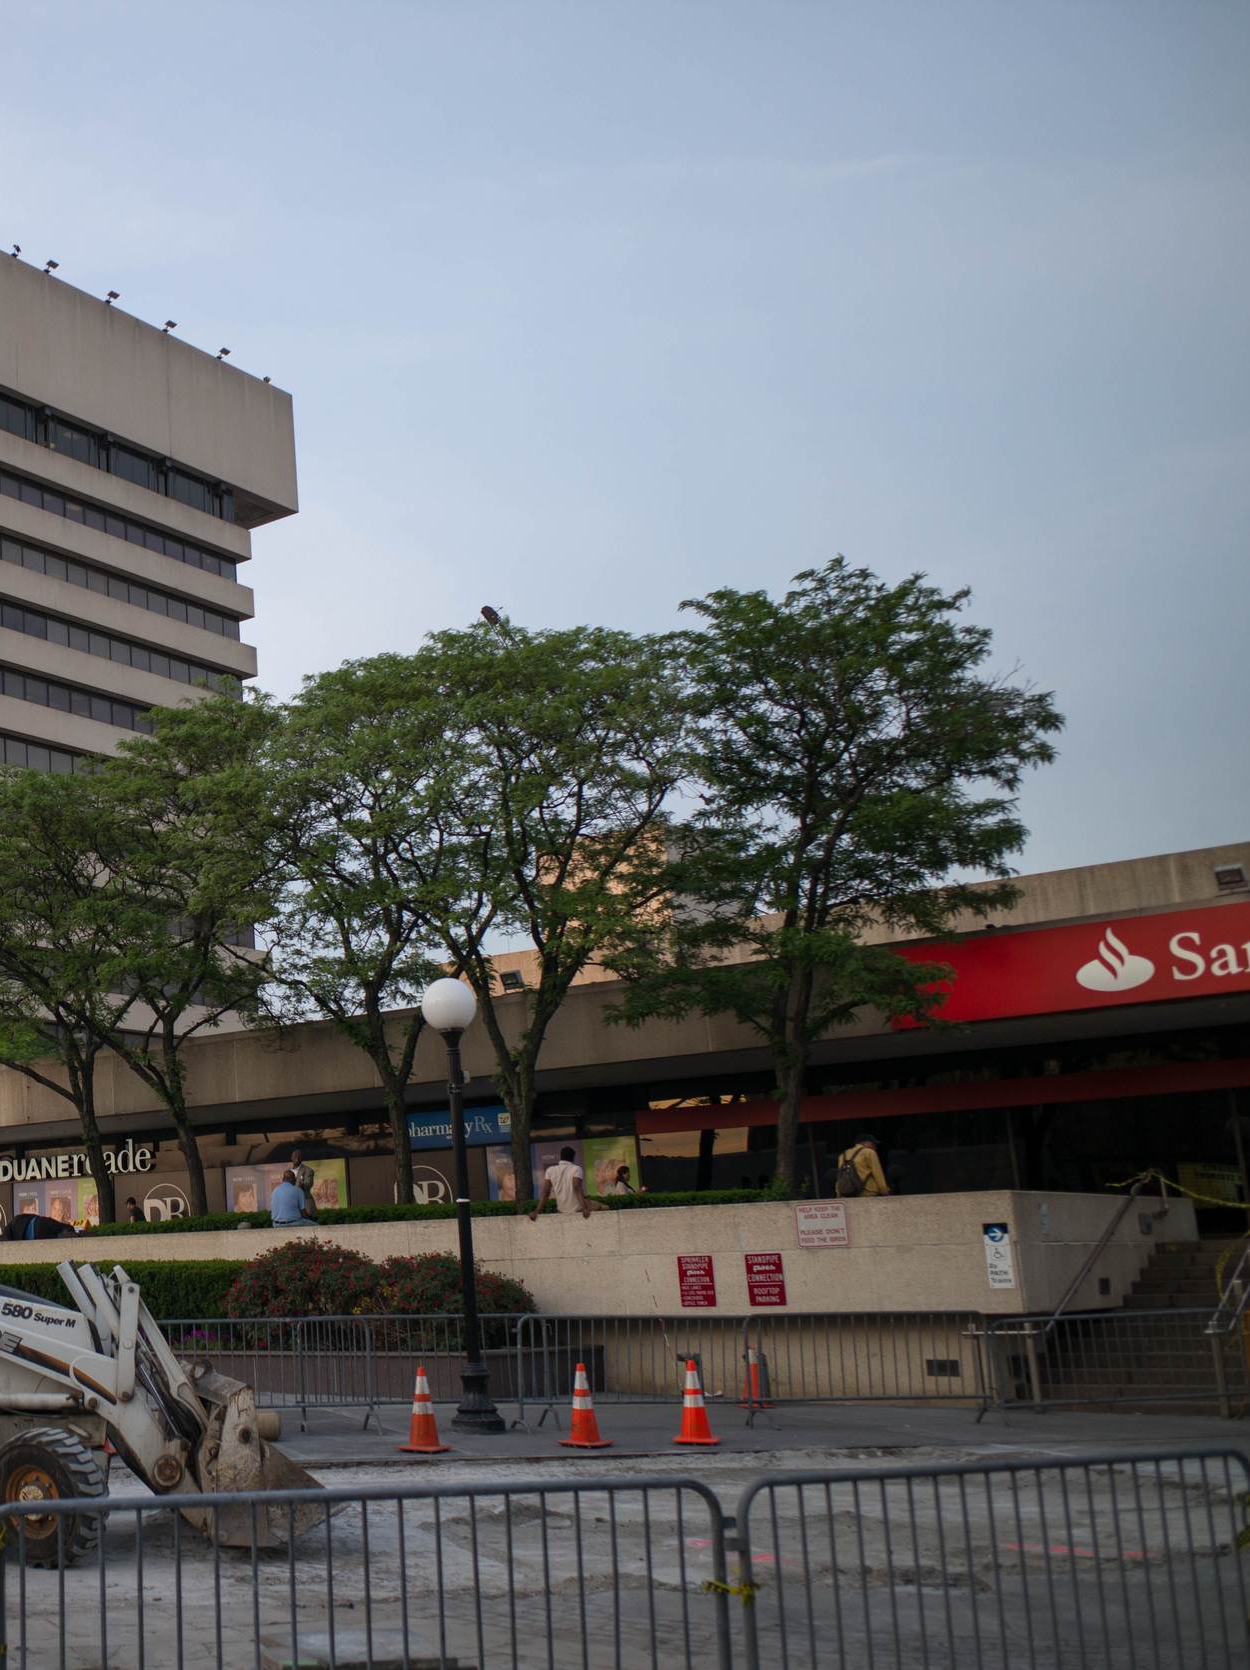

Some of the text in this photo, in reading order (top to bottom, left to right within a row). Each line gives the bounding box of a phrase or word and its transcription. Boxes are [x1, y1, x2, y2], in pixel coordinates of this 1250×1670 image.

[1169, 931, 1250, 981] Sa
[408, 1121, 474, 1139] harmay
[747, 1255, 779, 1264] STANDPIPE
[747, 1273, 784, 1282] CONNECTION
[753, 1287, 780, 1295] ROOFTOP
[755, 1295, 781, 1303] PARKING
[1, 1302, 76, 1328] 580 Super M
